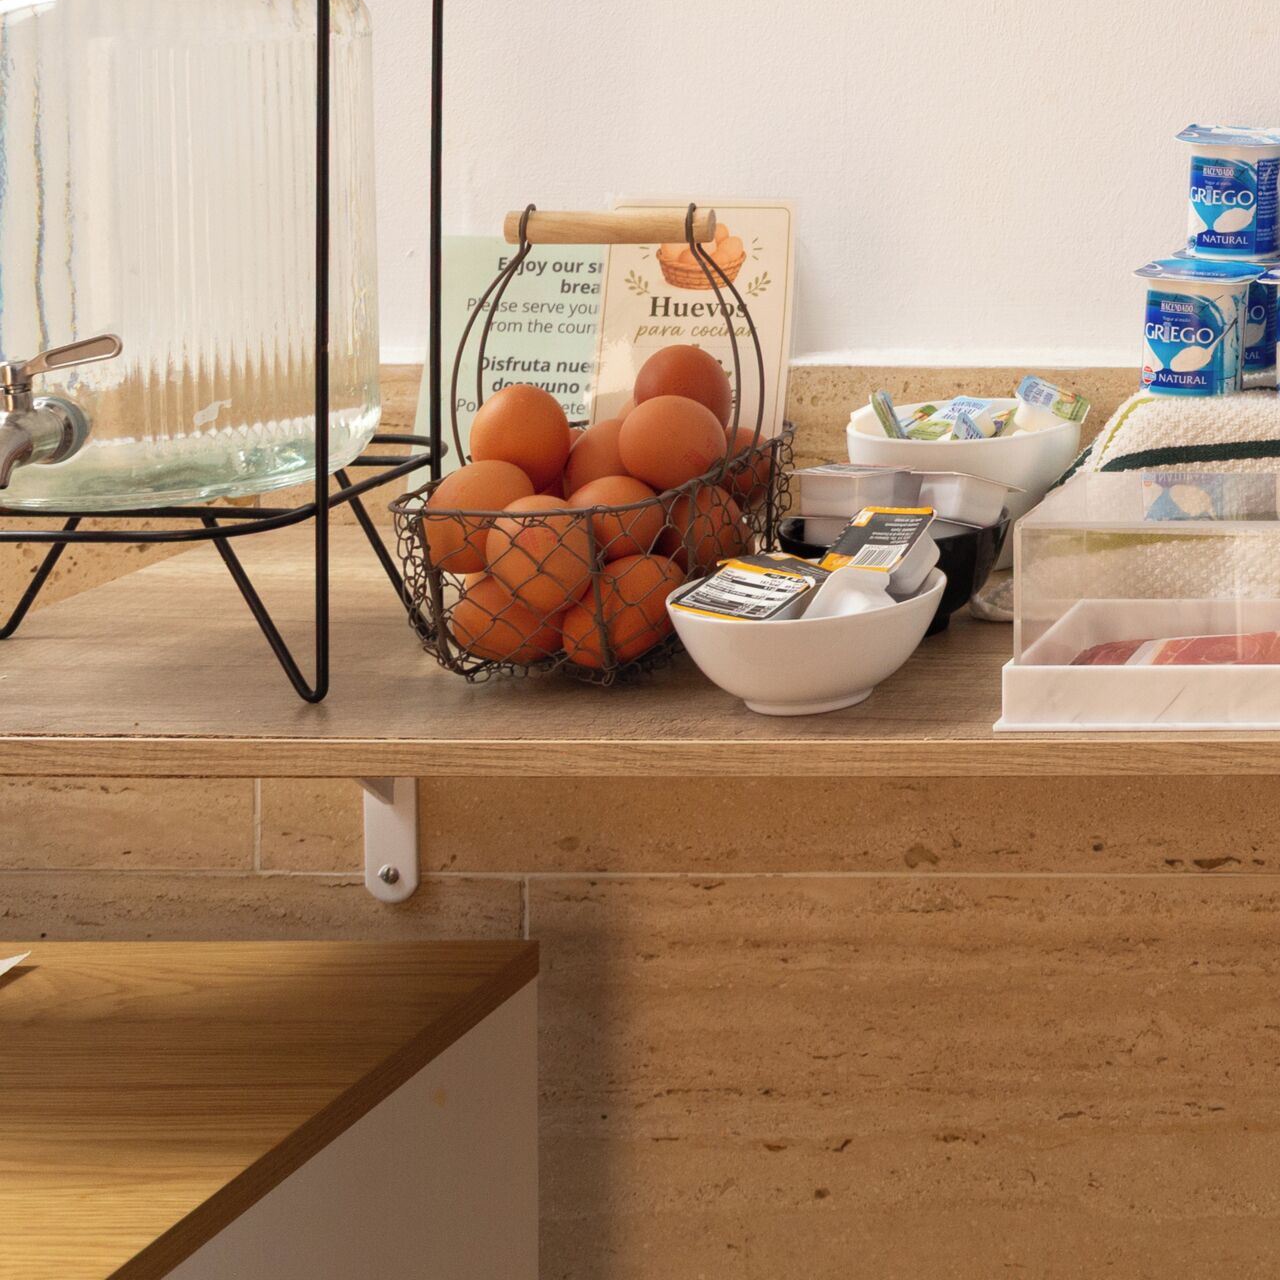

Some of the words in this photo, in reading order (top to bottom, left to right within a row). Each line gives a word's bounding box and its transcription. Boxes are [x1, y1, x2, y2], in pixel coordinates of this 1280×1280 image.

[1190, 185, 1254, 206] GRIEGO
[1202, 233, 1249, 245] NATURAL
[497, 257, 549, 277] Ejoy
[552, 261, 584, 274] our
[522, 302, 565, 314] serve
[649, 296, 748, 318] Huevos
[488, 321, 522, 333] rom
[528, 318, 553, 333] the
[634, 325, 686, 343] para
[1145, 322, 1214, 344] GRIEGO
[481, 356, 551, 373] Disfruta
[492, 377, 580, 394] dyuno
[1158, 373, 1207, 385] NATURAL
